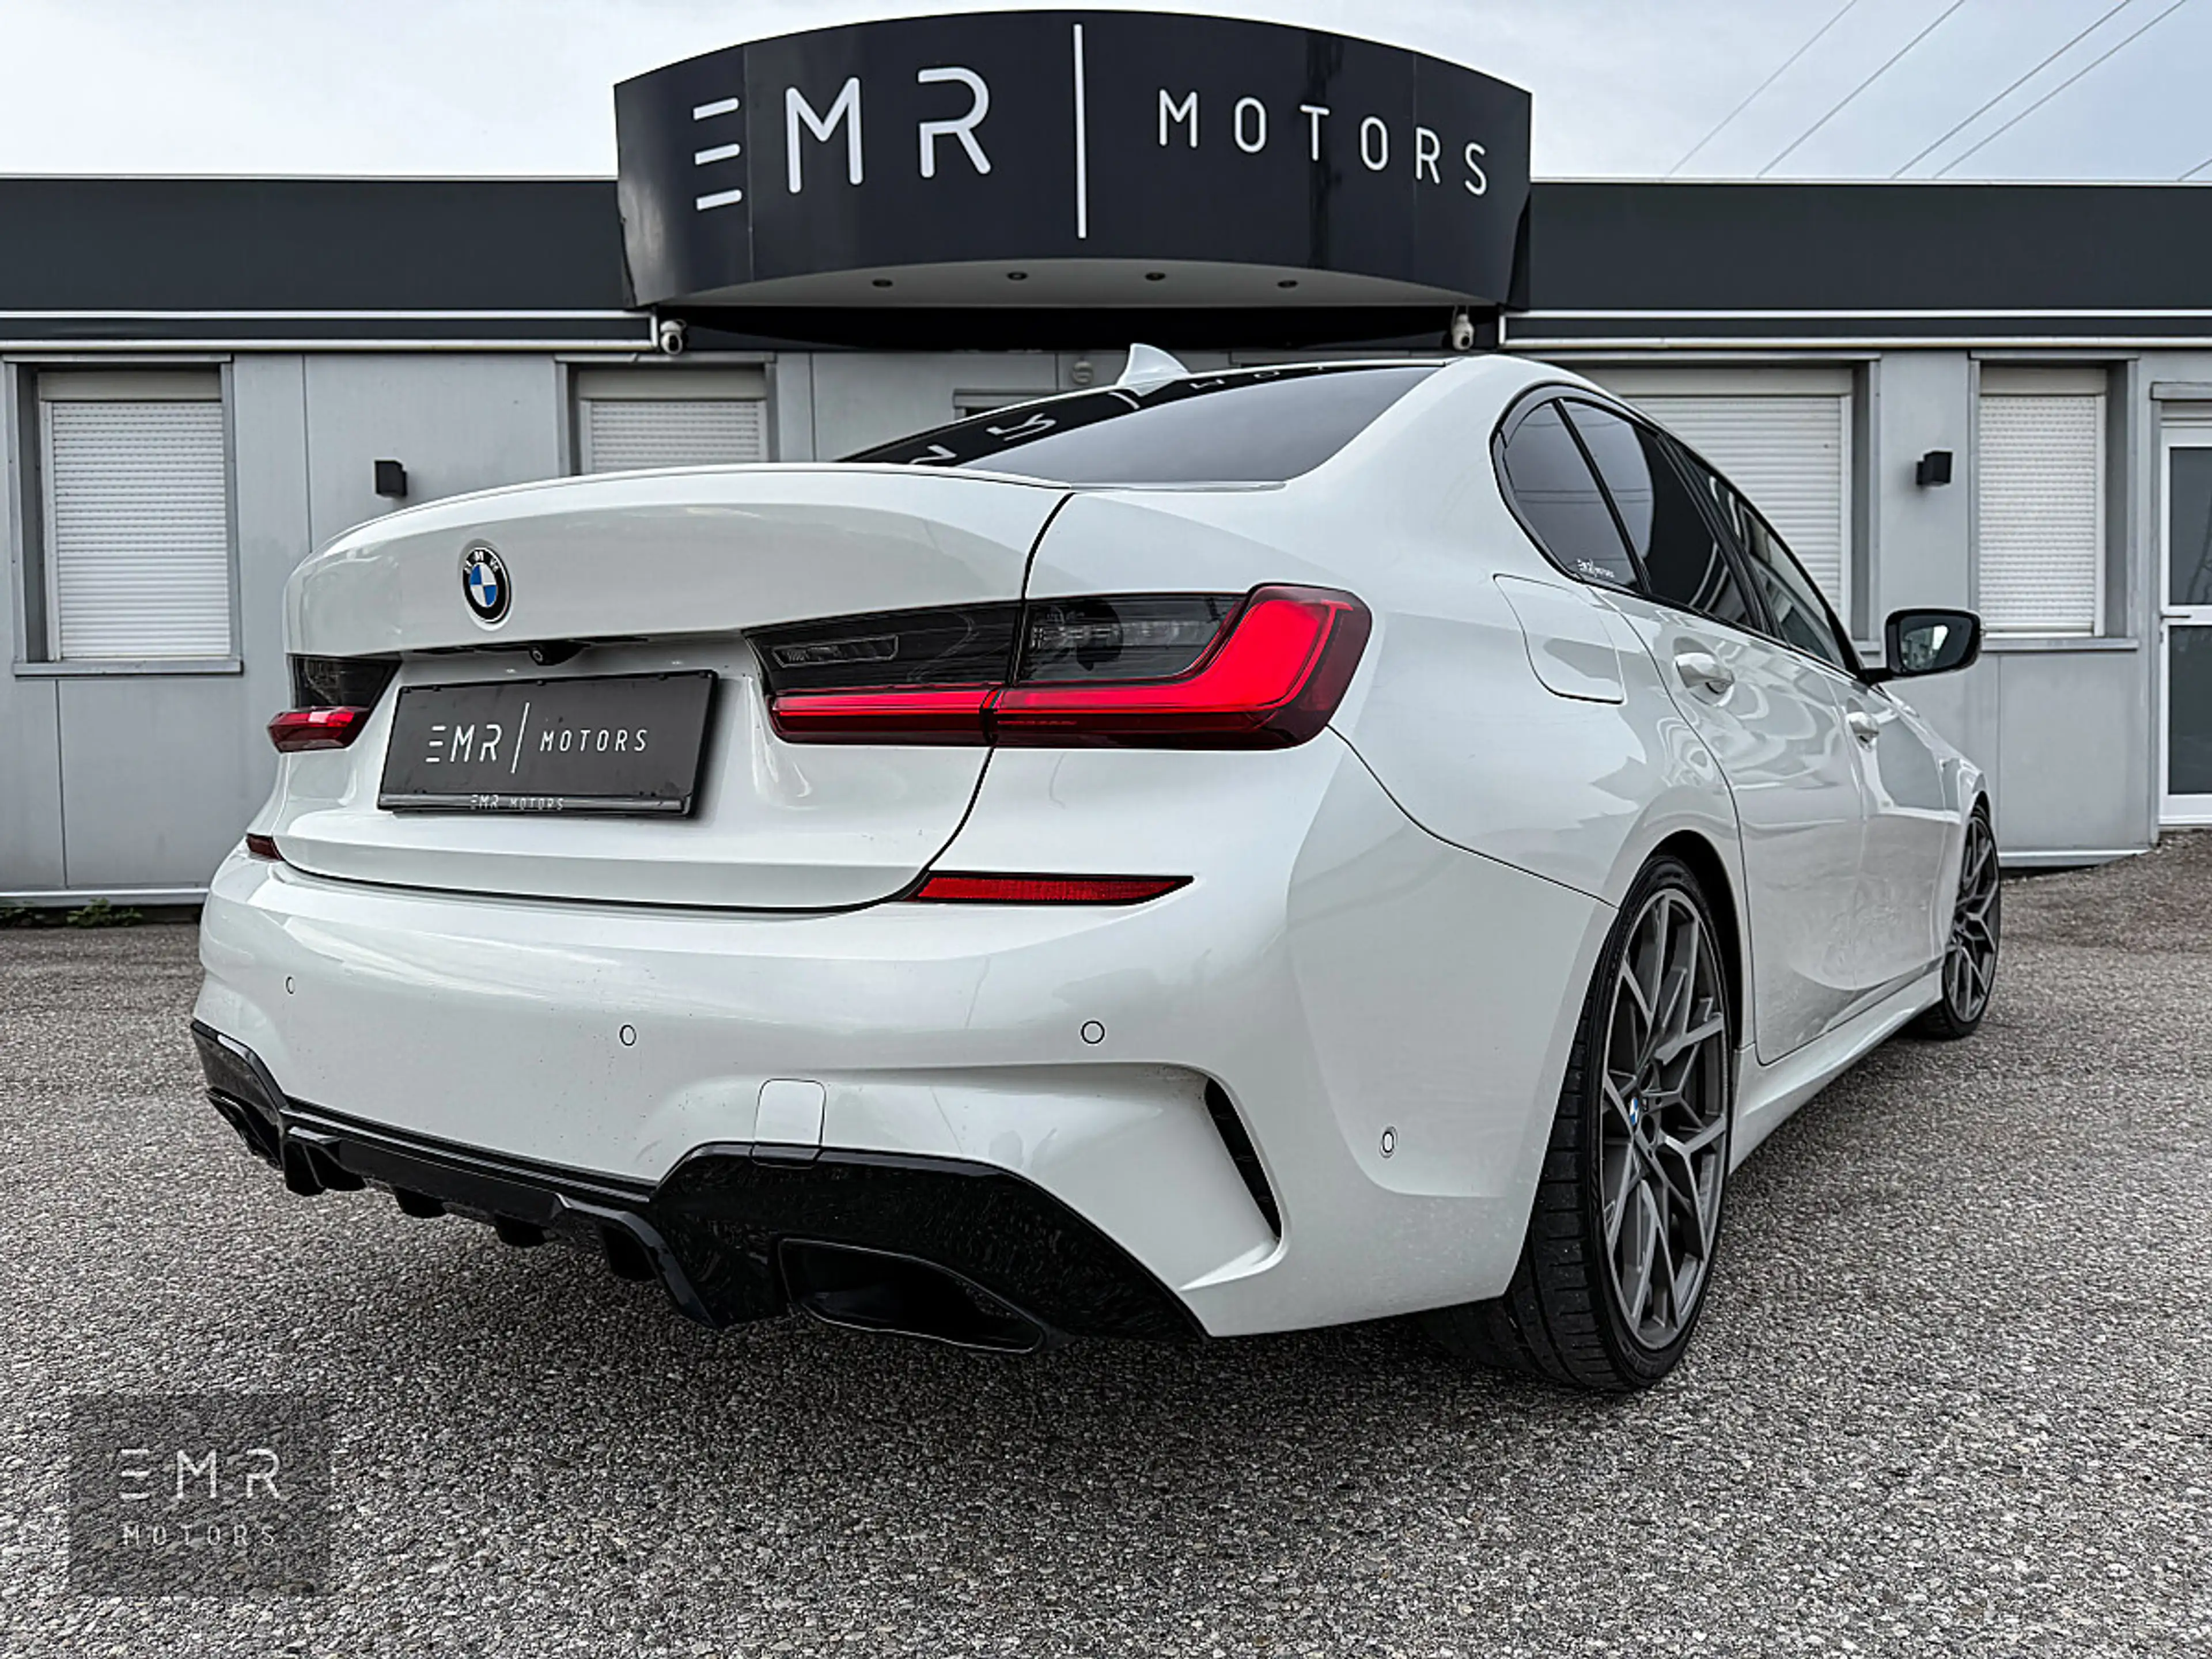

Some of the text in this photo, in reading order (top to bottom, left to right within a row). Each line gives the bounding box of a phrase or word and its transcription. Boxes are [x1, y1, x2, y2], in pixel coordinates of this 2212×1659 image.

[693, 67, 1487, 211] EMR MOTORS
[425, 724, 647, 763] EMR MOTORS
[470, 794, 564, 810] EMR MOTORS
